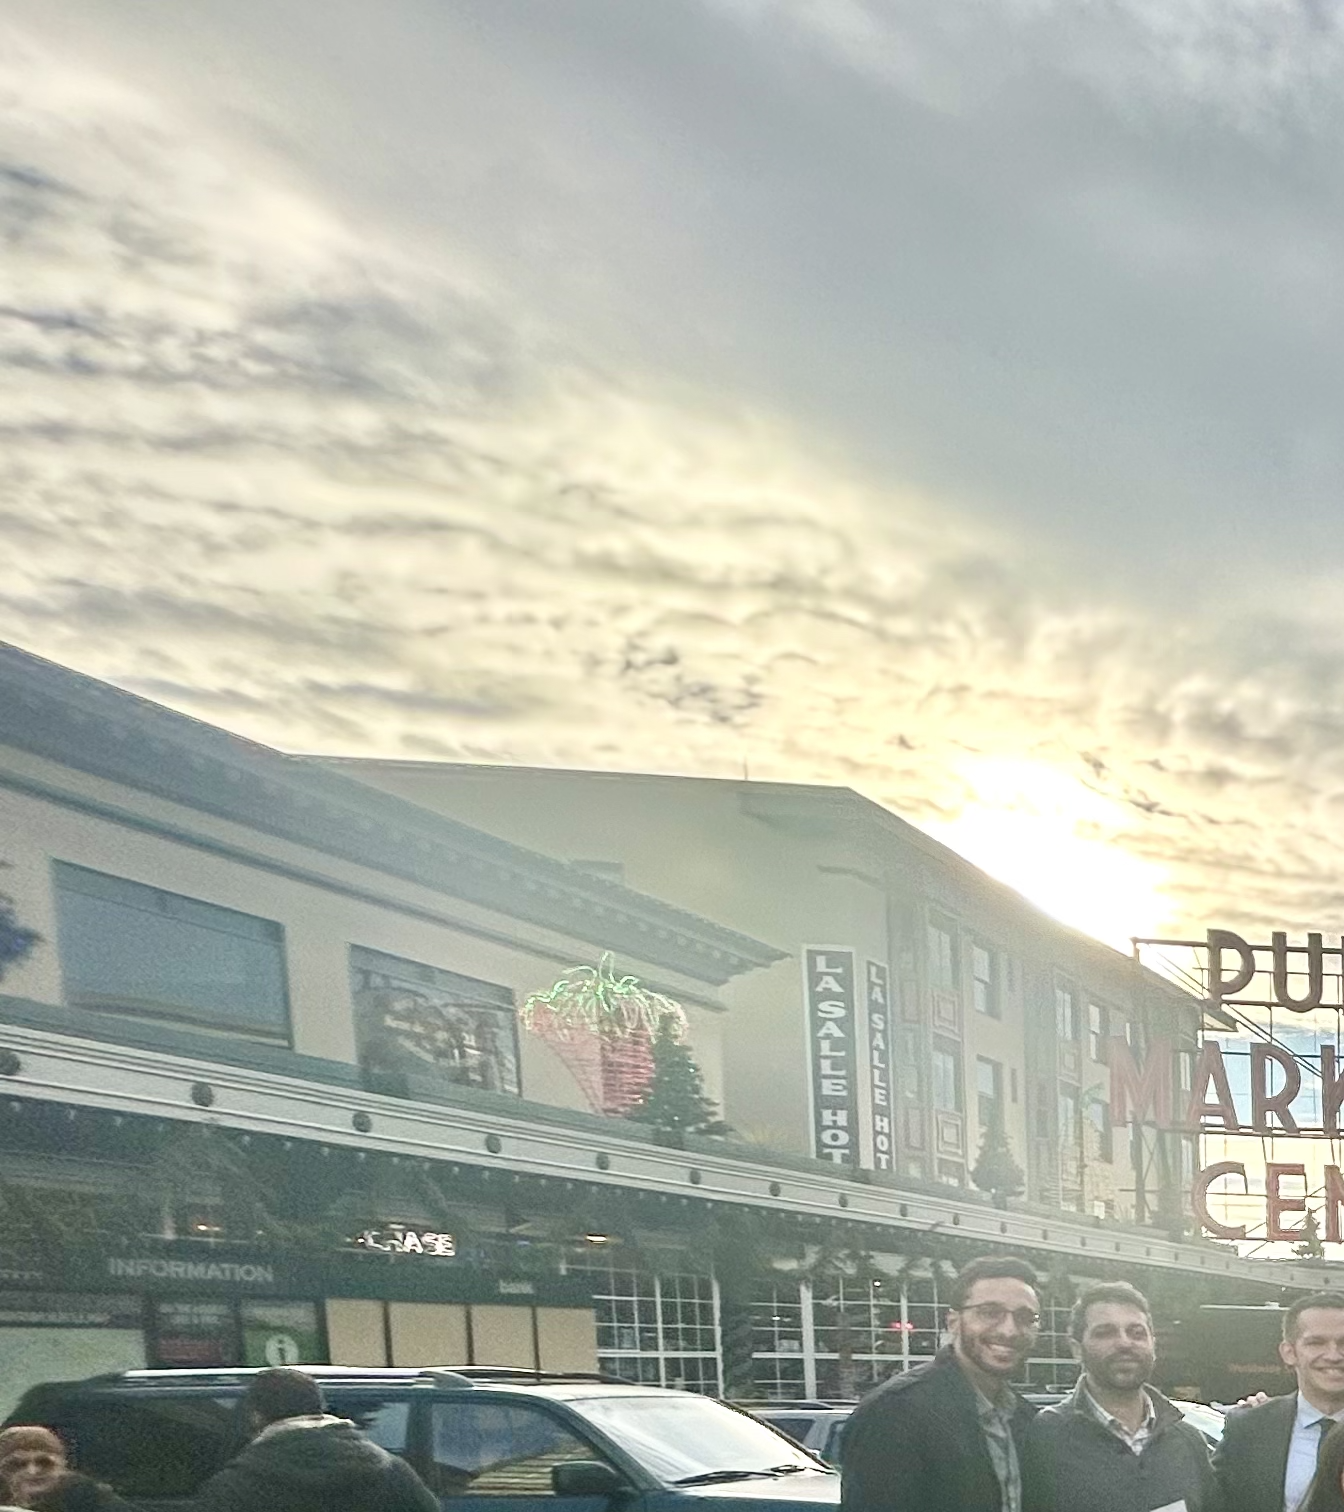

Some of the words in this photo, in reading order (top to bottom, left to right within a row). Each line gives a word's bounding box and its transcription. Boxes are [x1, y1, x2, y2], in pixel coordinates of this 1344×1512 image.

[815, 955, 845, 993] LA
[869, 965, 885, 1004] LA
[816, 1000, 849, 1097] SALLE
[871, 1013, 888, 1106] SALLE
[108, 1257, 274, 1282] INFORMATION
